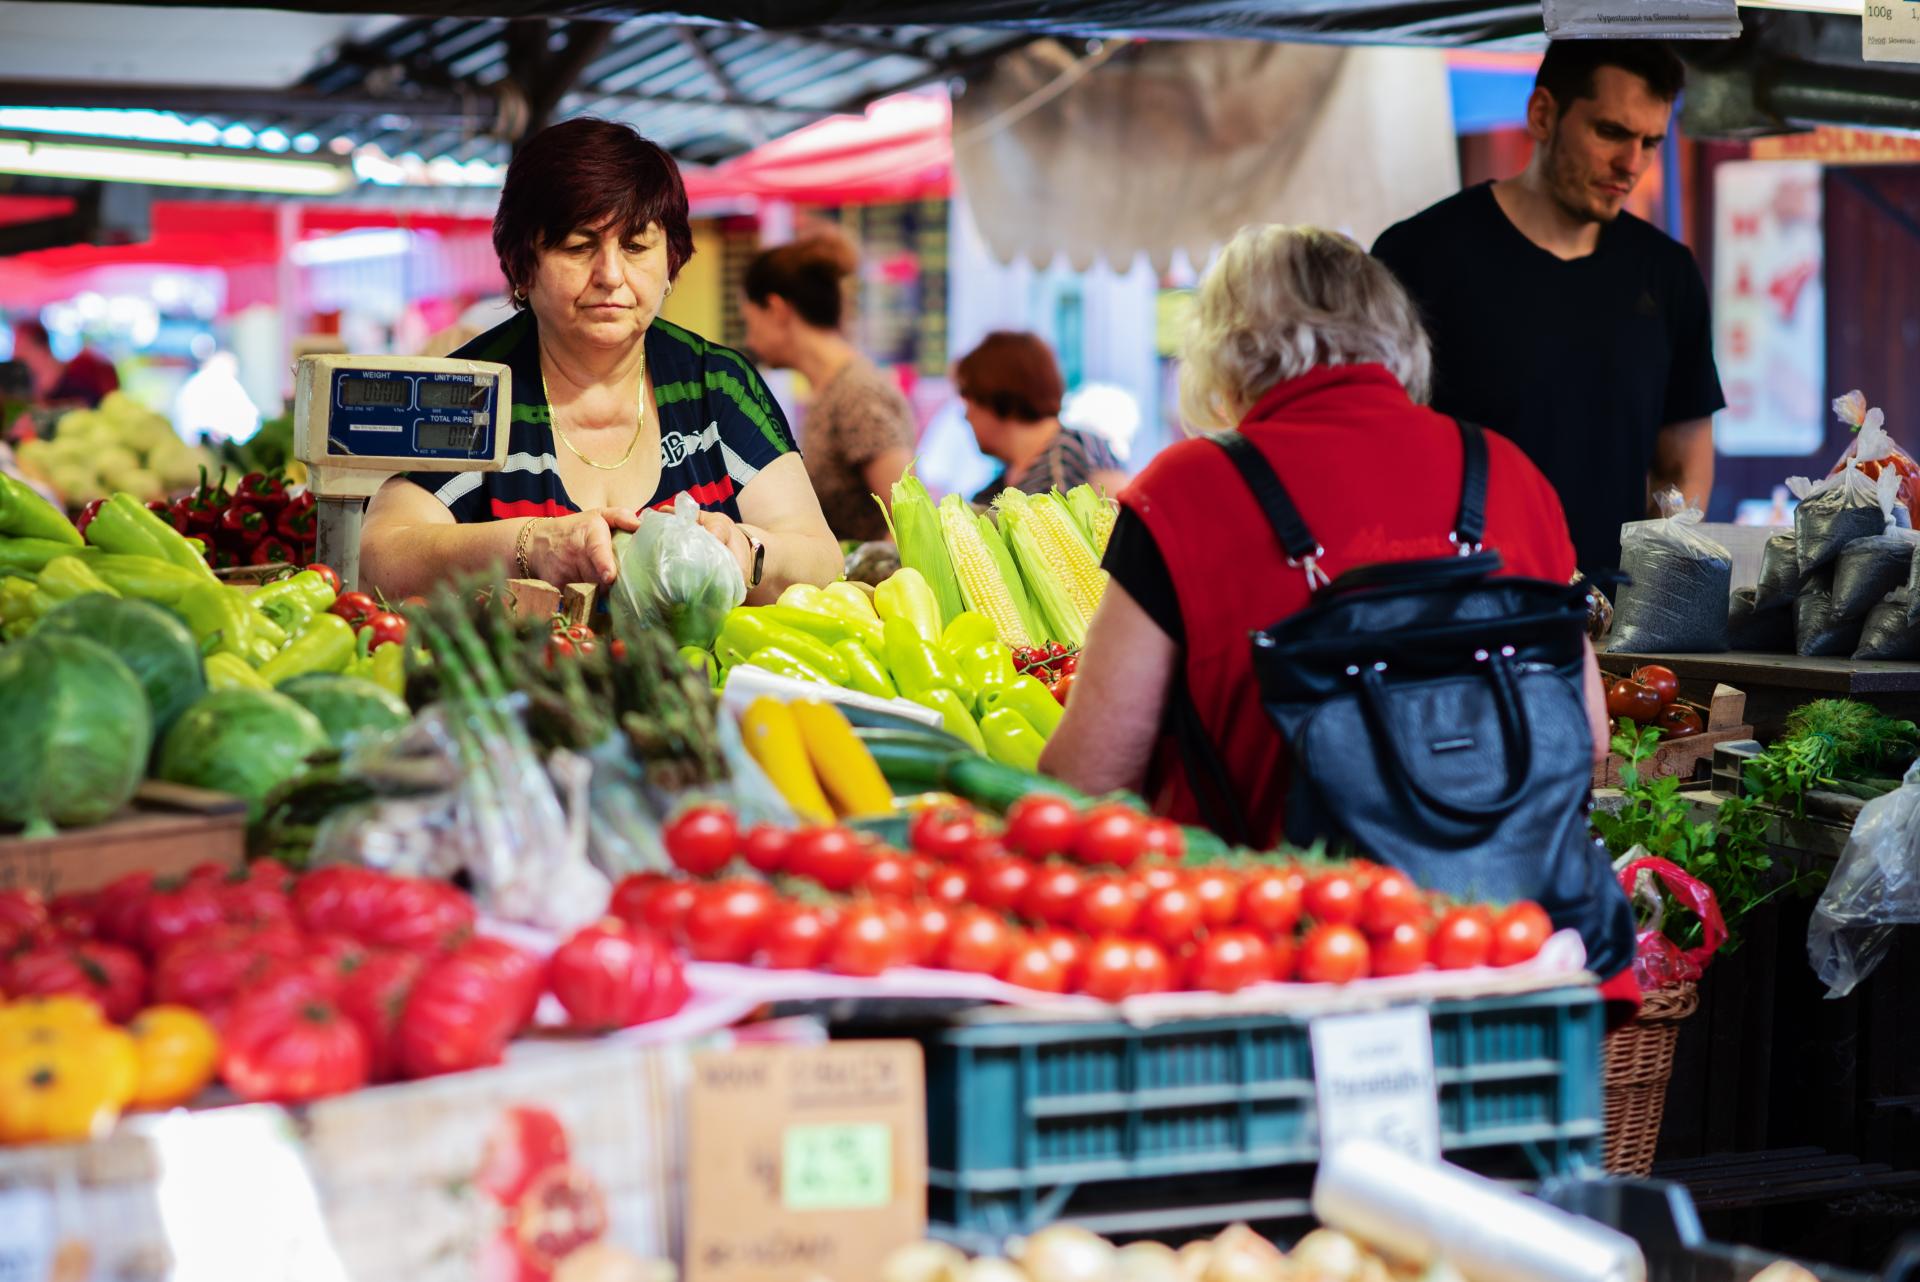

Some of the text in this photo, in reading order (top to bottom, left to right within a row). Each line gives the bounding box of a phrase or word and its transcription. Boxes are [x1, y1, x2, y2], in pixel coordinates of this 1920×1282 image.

[1868, 6, 1892, 20] 100g
[362, 371, 391, 379] WEIGHT
[430, 415, 451, 423] TOTAL
